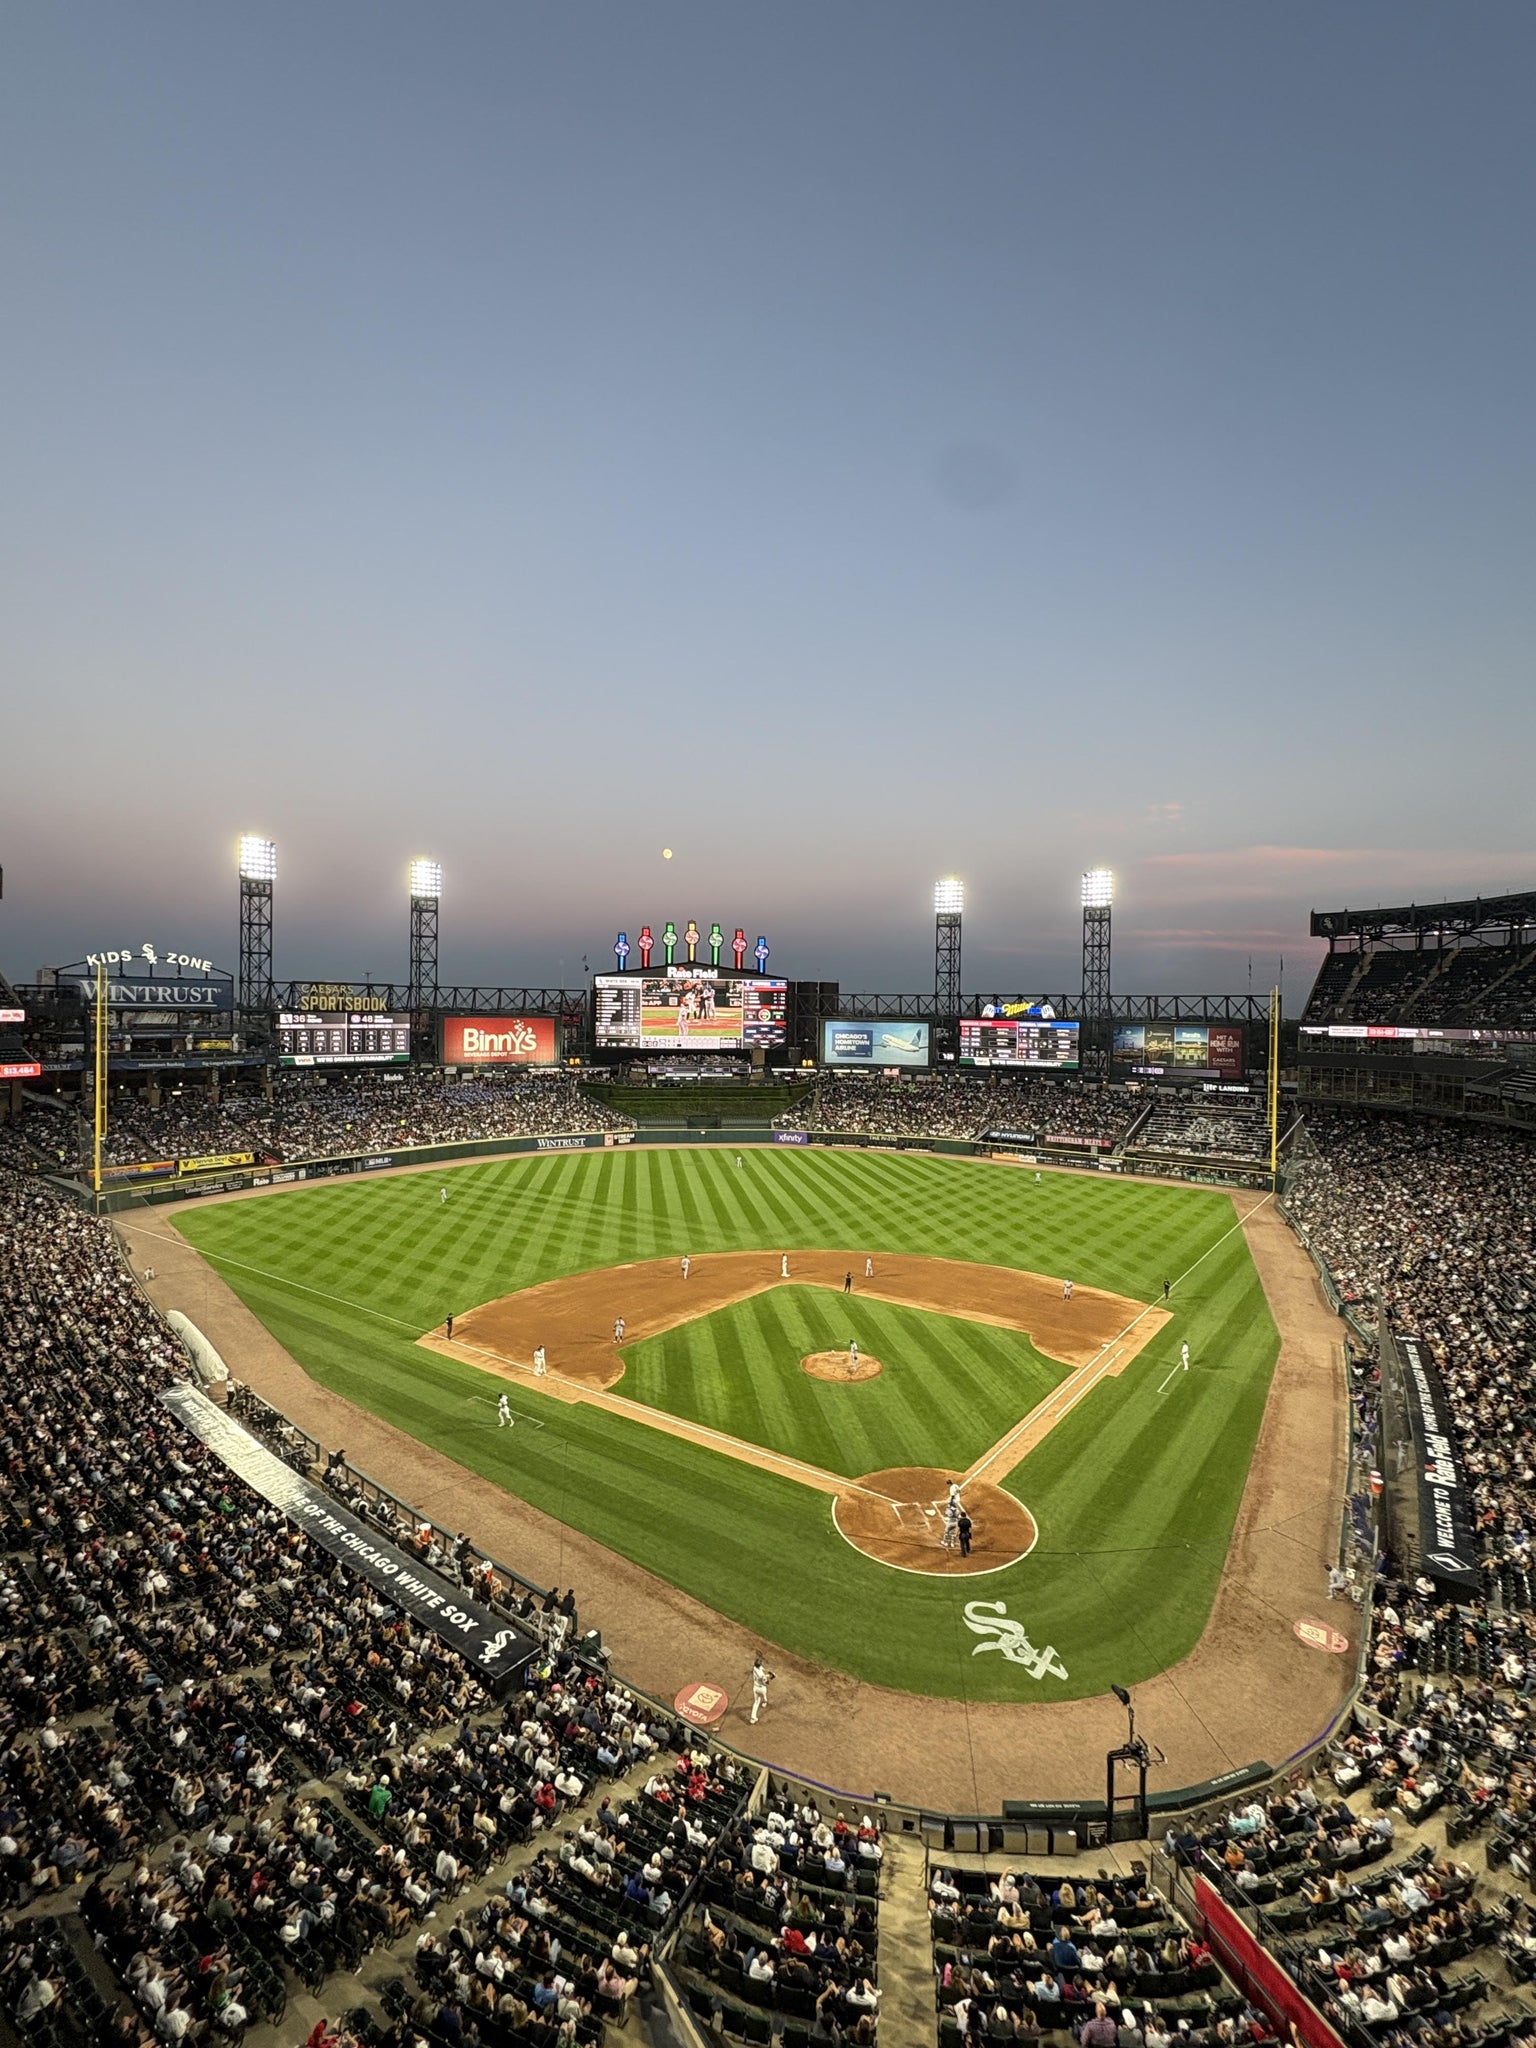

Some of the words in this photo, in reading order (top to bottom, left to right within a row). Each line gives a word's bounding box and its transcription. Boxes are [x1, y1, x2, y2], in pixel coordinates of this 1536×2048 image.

[86, 950, 132, 967] KIDS
[166, 952, 212, 972] ZONE
[667, 966, 692, 978] Rate
[692, 968, 718, 978] Field
[300, 984, 354, 994] CAESARS
[300, 996, 388, 1011] SPORTSBOOK
[463, 1027, 537, 1055] Binny's
[537, 1138, 586, 1147] WINTRUST
[778, 1133, 802, 1143] xfinity
[1412, 1369, 1430, 1392] CHICAGO
[1419, 1392, 1433, 1404] THE
[1422, 1413, 1439, 1432] HOME
[1424, 1432, 1455, 1462] Field
[1425, 1463, 1457, 1487] Rate
[1434, 1487, 1450, 1500] TO
[1436, 1501, 1455, 1548] WELCOME
[304, 1504, 326, 1517] OF
[318, 1515, 347, 1535] THE
[340, 1532, 399, 1574] CHICAGO
[394, 1571, 446, 1608] WHITE
[440, 1605, 479, 1632] SOX
